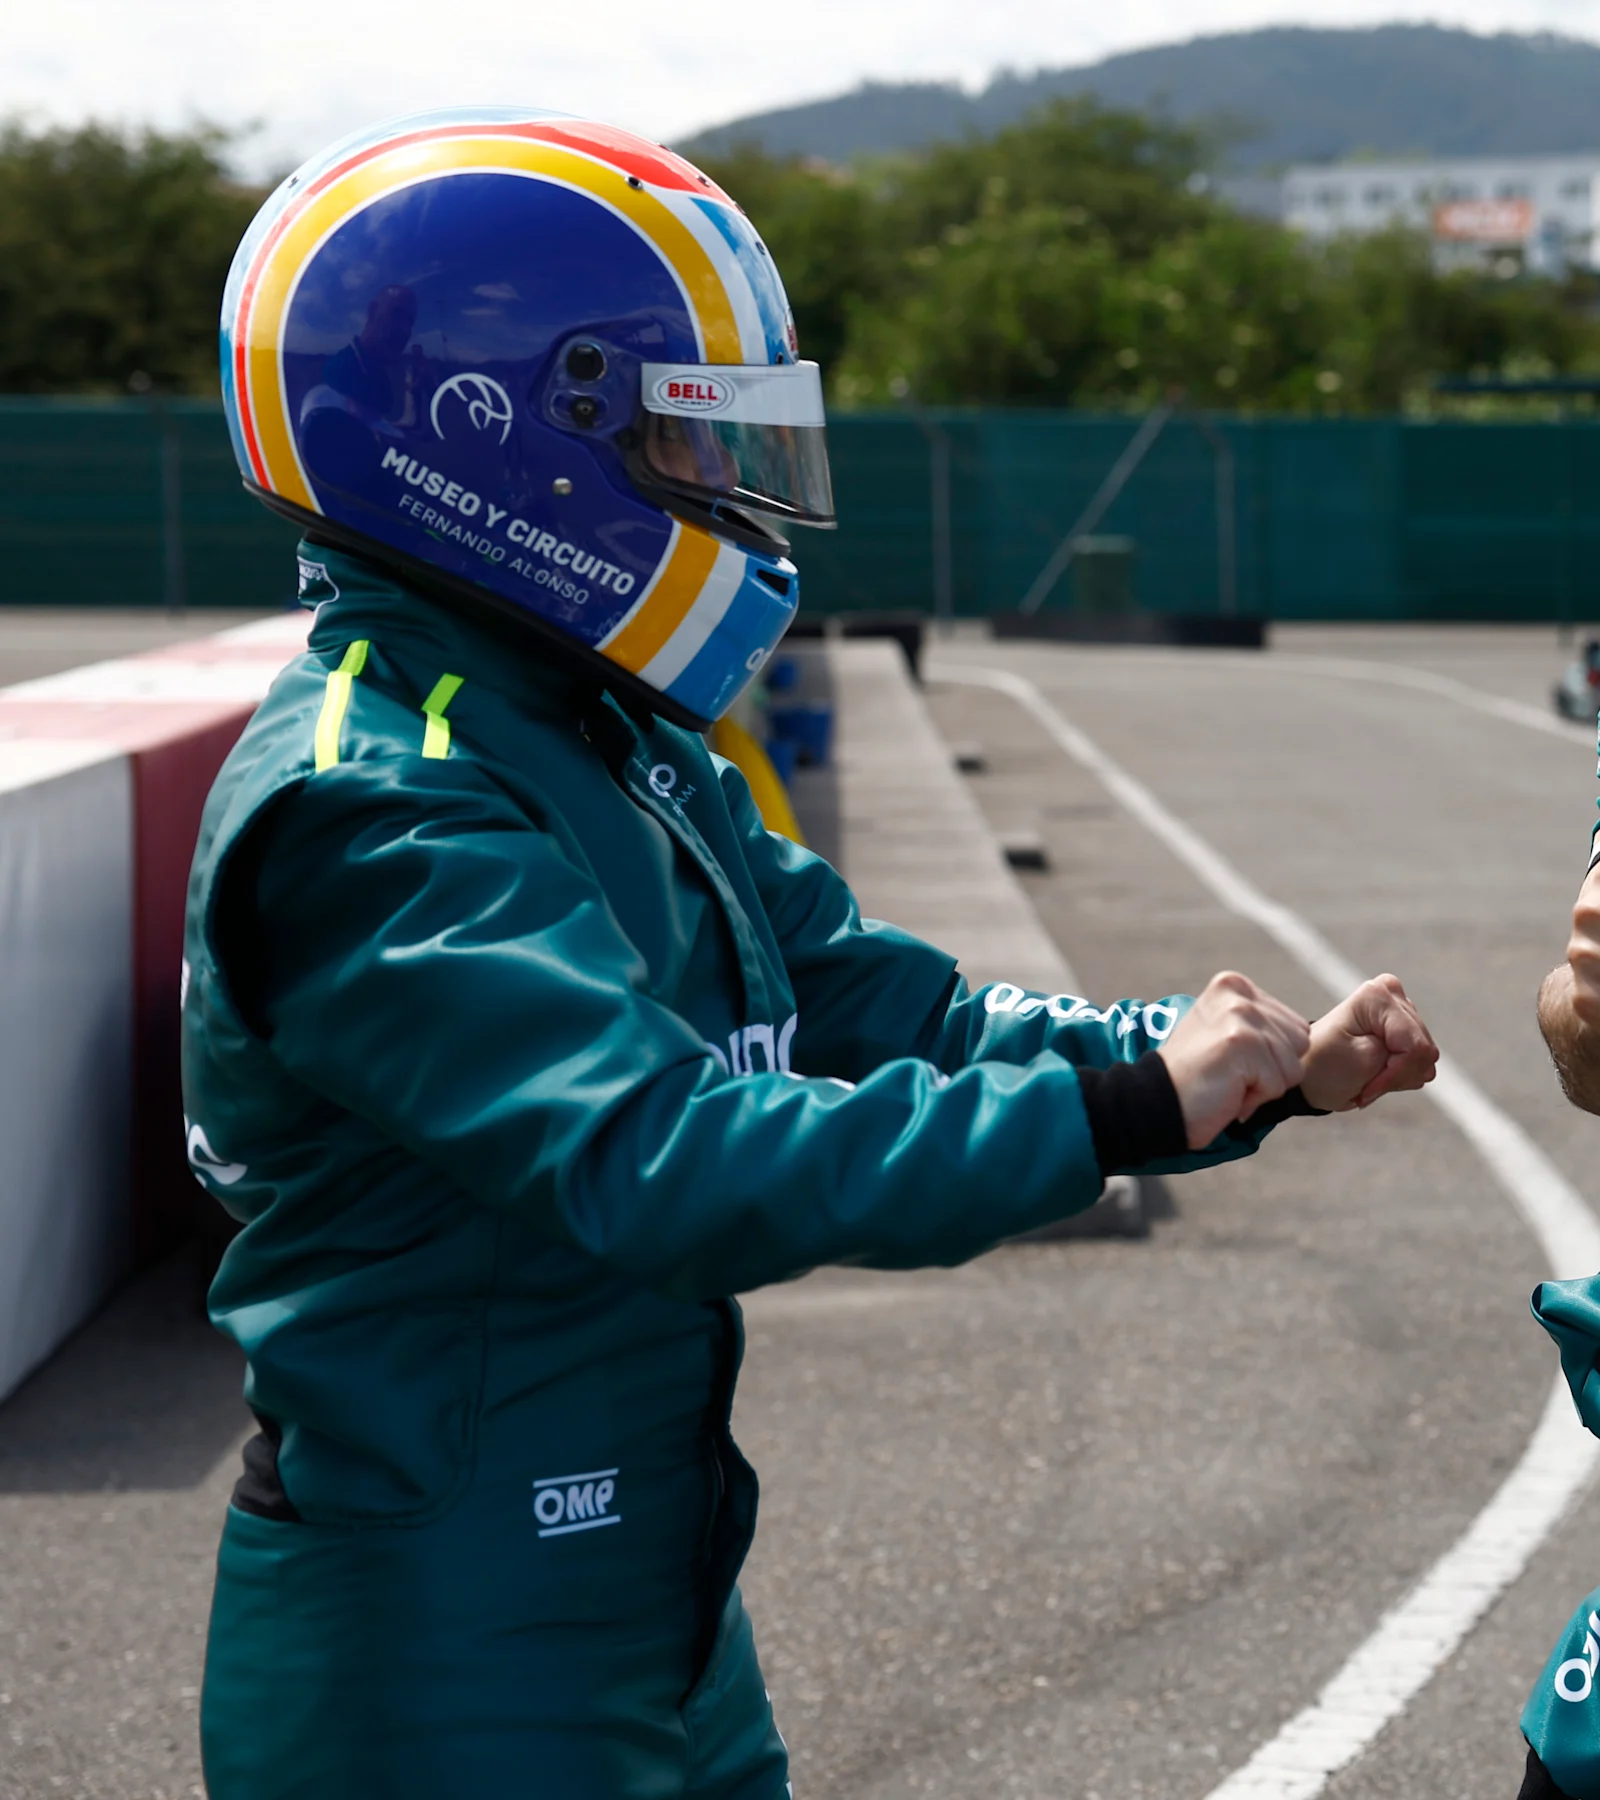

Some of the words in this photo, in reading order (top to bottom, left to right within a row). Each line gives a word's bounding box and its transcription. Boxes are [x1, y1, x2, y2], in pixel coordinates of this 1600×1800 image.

[667, 382, 718, 401] BELL
[381, 446, 482, 517] MUSEO
[485, 503, 508, 529] Y
[506, 518, 636, 596] CIRCUITO
[398, 493, 507, 563] FERNANDO
[508, 557, 590, 606] ALONSO
[533, 1478, 615, 1526] OMP
